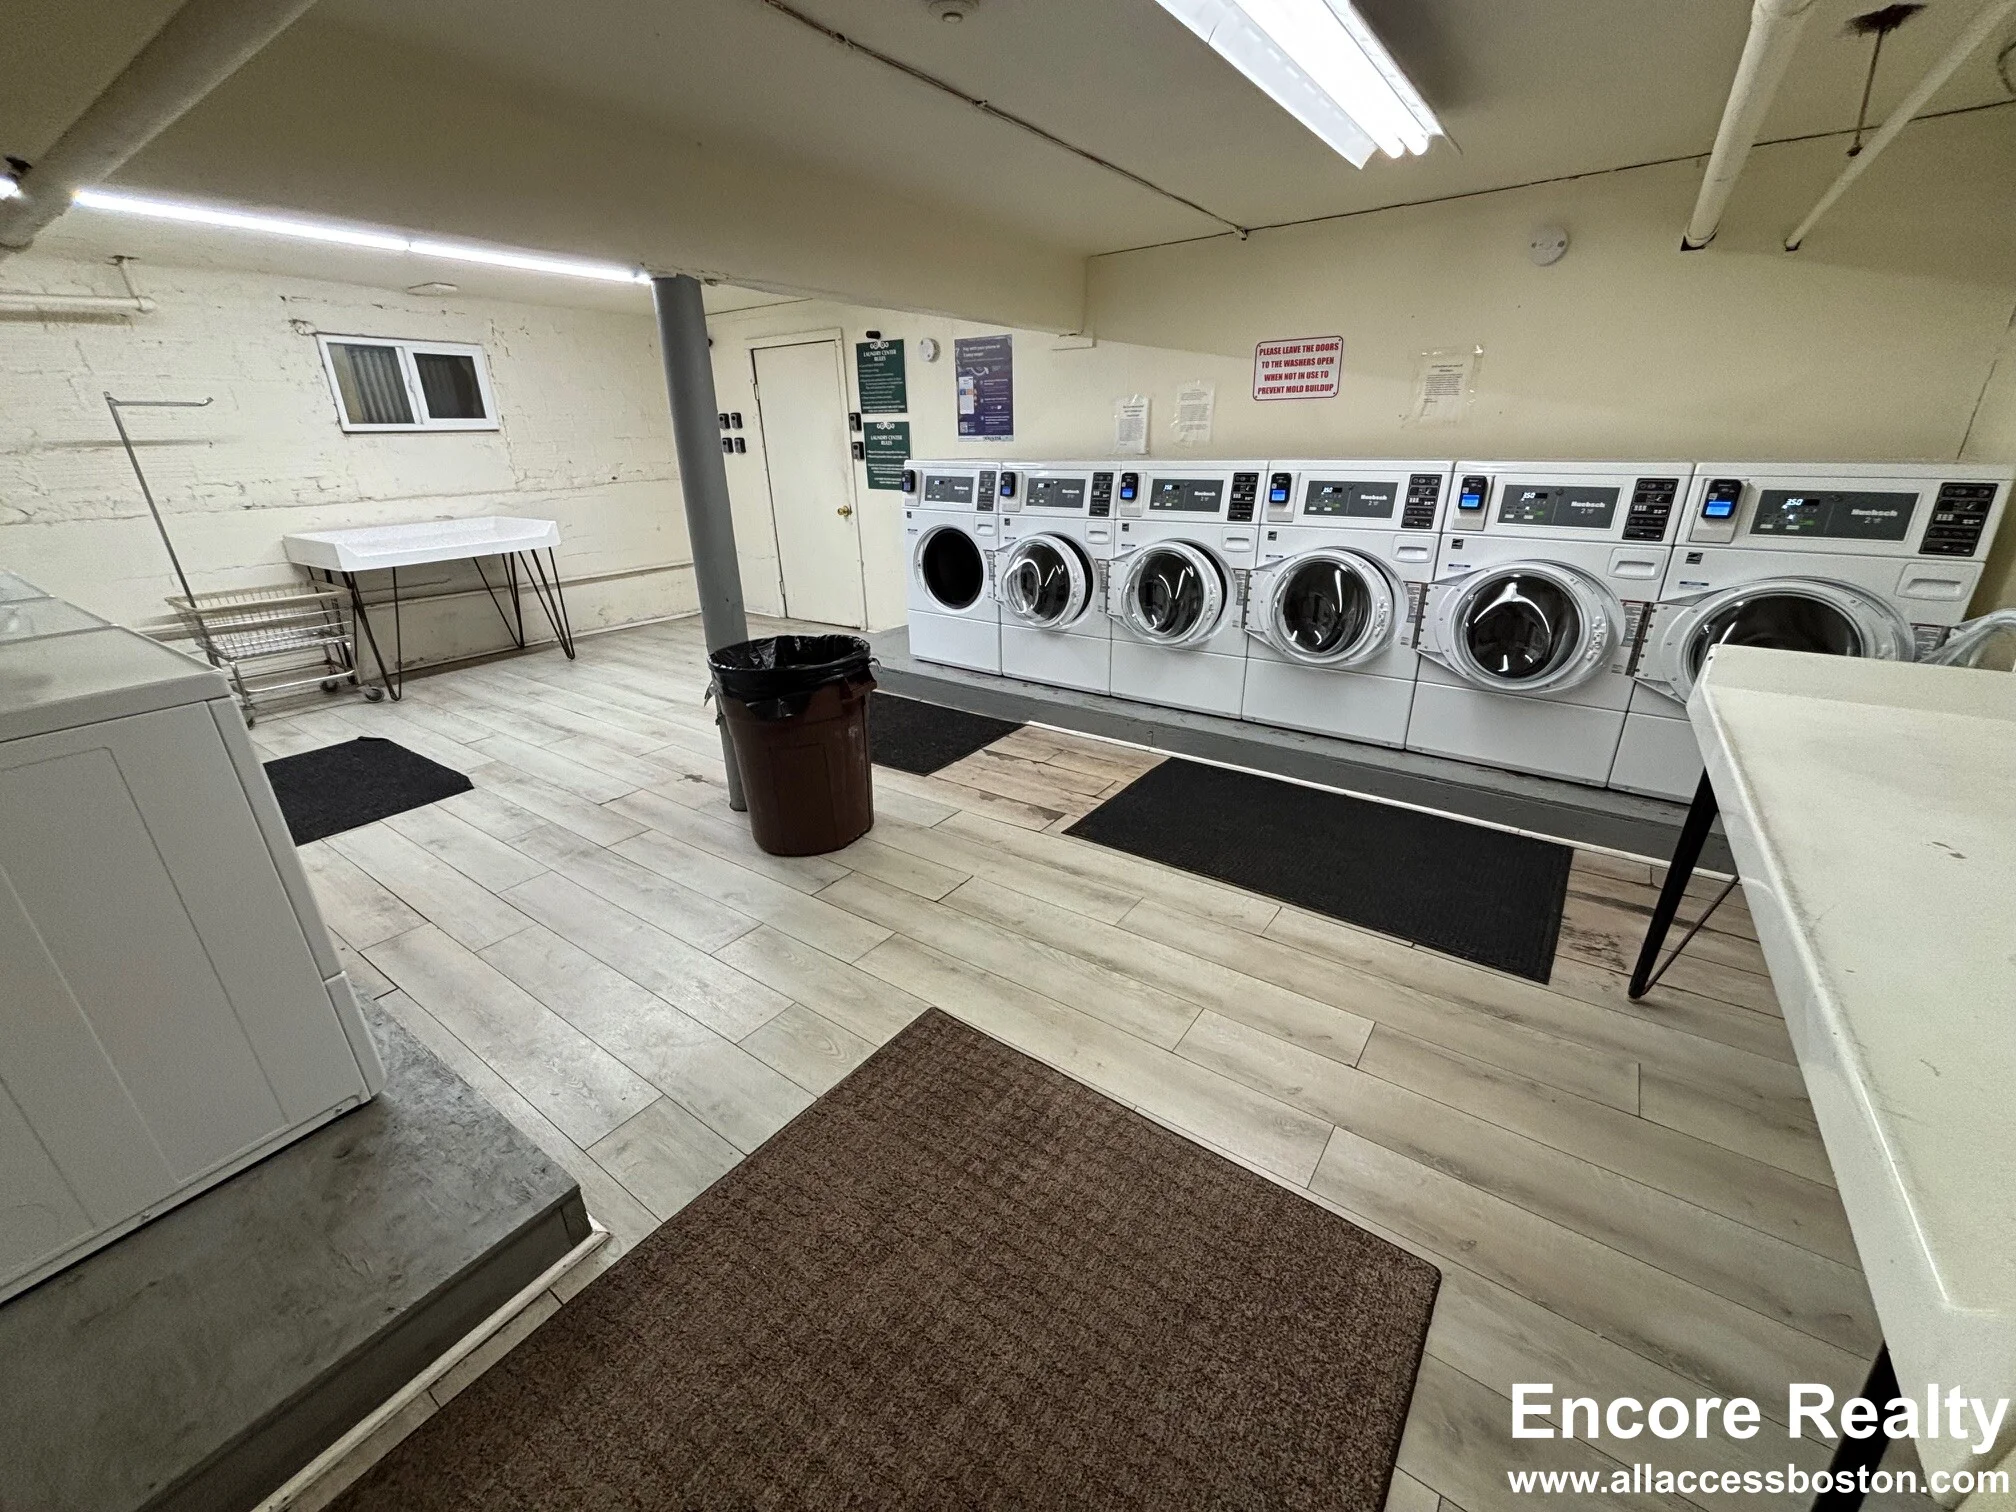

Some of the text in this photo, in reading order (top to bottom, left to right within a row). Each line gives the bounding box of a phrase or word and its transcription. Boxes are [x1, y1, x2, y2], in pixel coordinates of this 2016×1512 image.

[1259, 343, 1339, 356] PLEASE LEAVE THE DOORS
[1262, 357, 1335, 369] TO THE WASHERS OPEN
[1264, 370, 1329, 382] WHEN NOT IN USE TO
[1257, 383, 1334, 395] PREVENT MOLD BUILDUP
[1850, 508, 1898, 517] Huebsch
